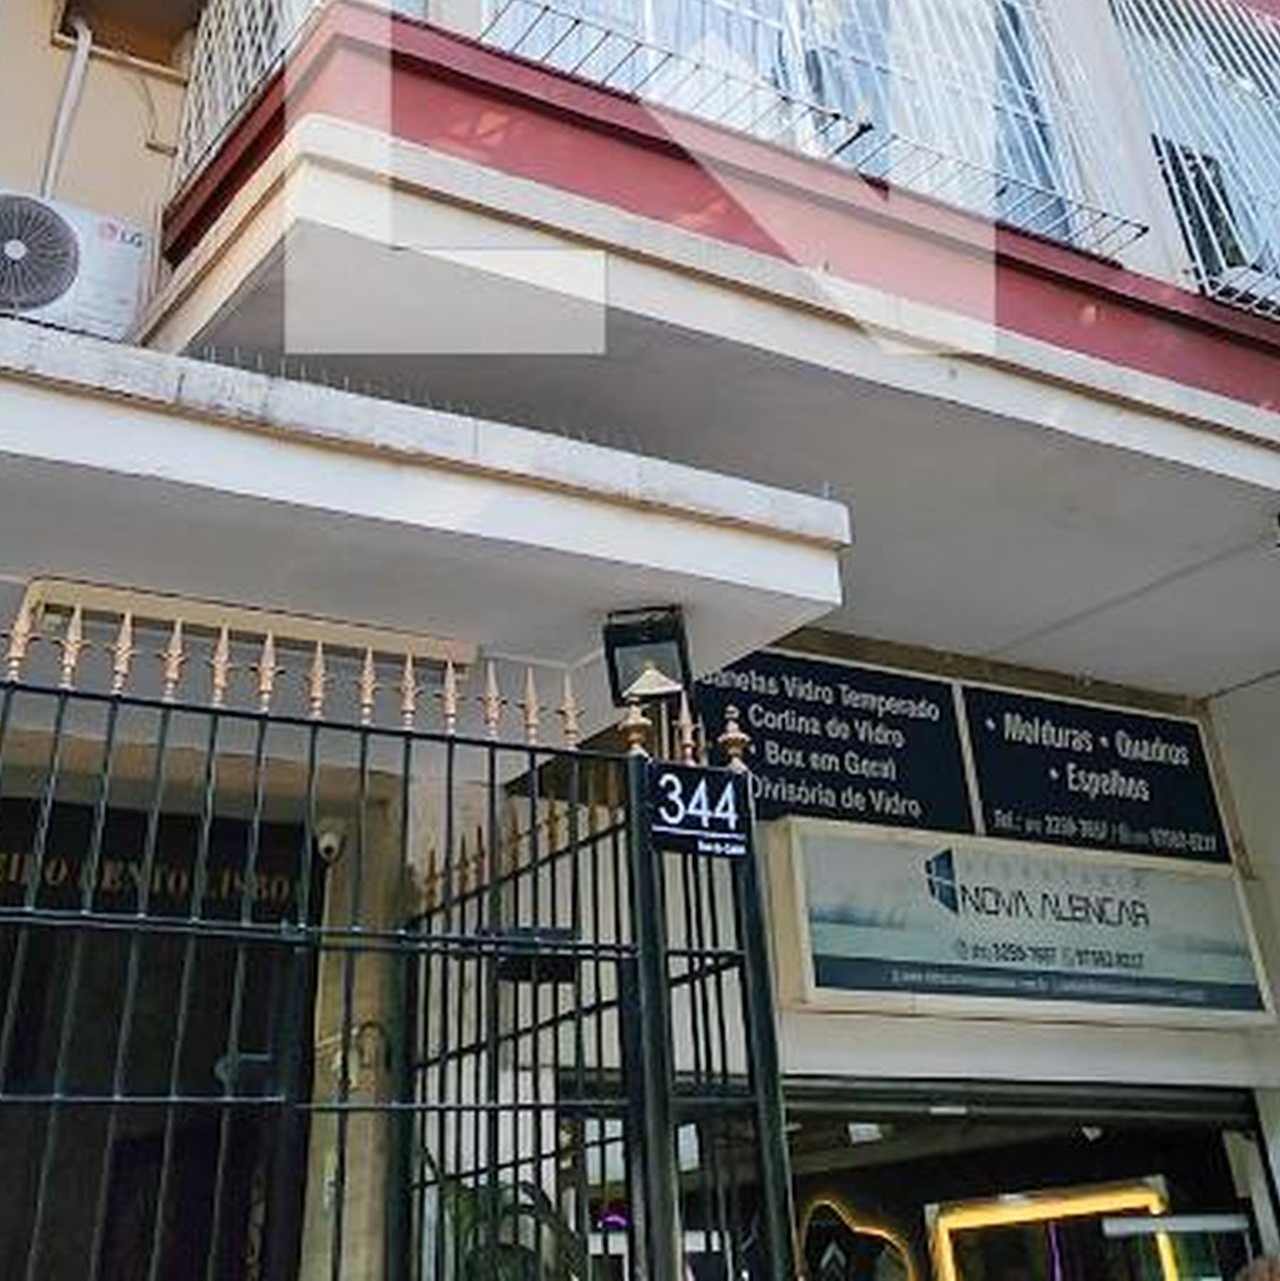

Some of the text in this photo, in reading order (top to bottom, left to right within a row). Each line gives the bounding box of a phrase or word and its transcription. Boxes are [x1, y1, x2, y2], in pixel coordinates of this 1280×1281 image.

[120, 229, 144, 249] LG
[781, 674, 835, 706] Vidro
[837, 683, 941, 723] Temperado
[746, 702, 822, 736] Cortina
[853, 721, 907, 749] Vidro
[1003, 711, 1191, 766] Molduras Quadros
[763, 740, 807, 771] Box
[809, 752, 841, 773] em
[657, 772, 739, 831] 344
[839, 786, 867, 812] de
[867, 788, 922, 818] Vidro
[1065, 762, 1151, 803] Espelhos
[959, 883, 1151, 929] NOVA ALENCAR
